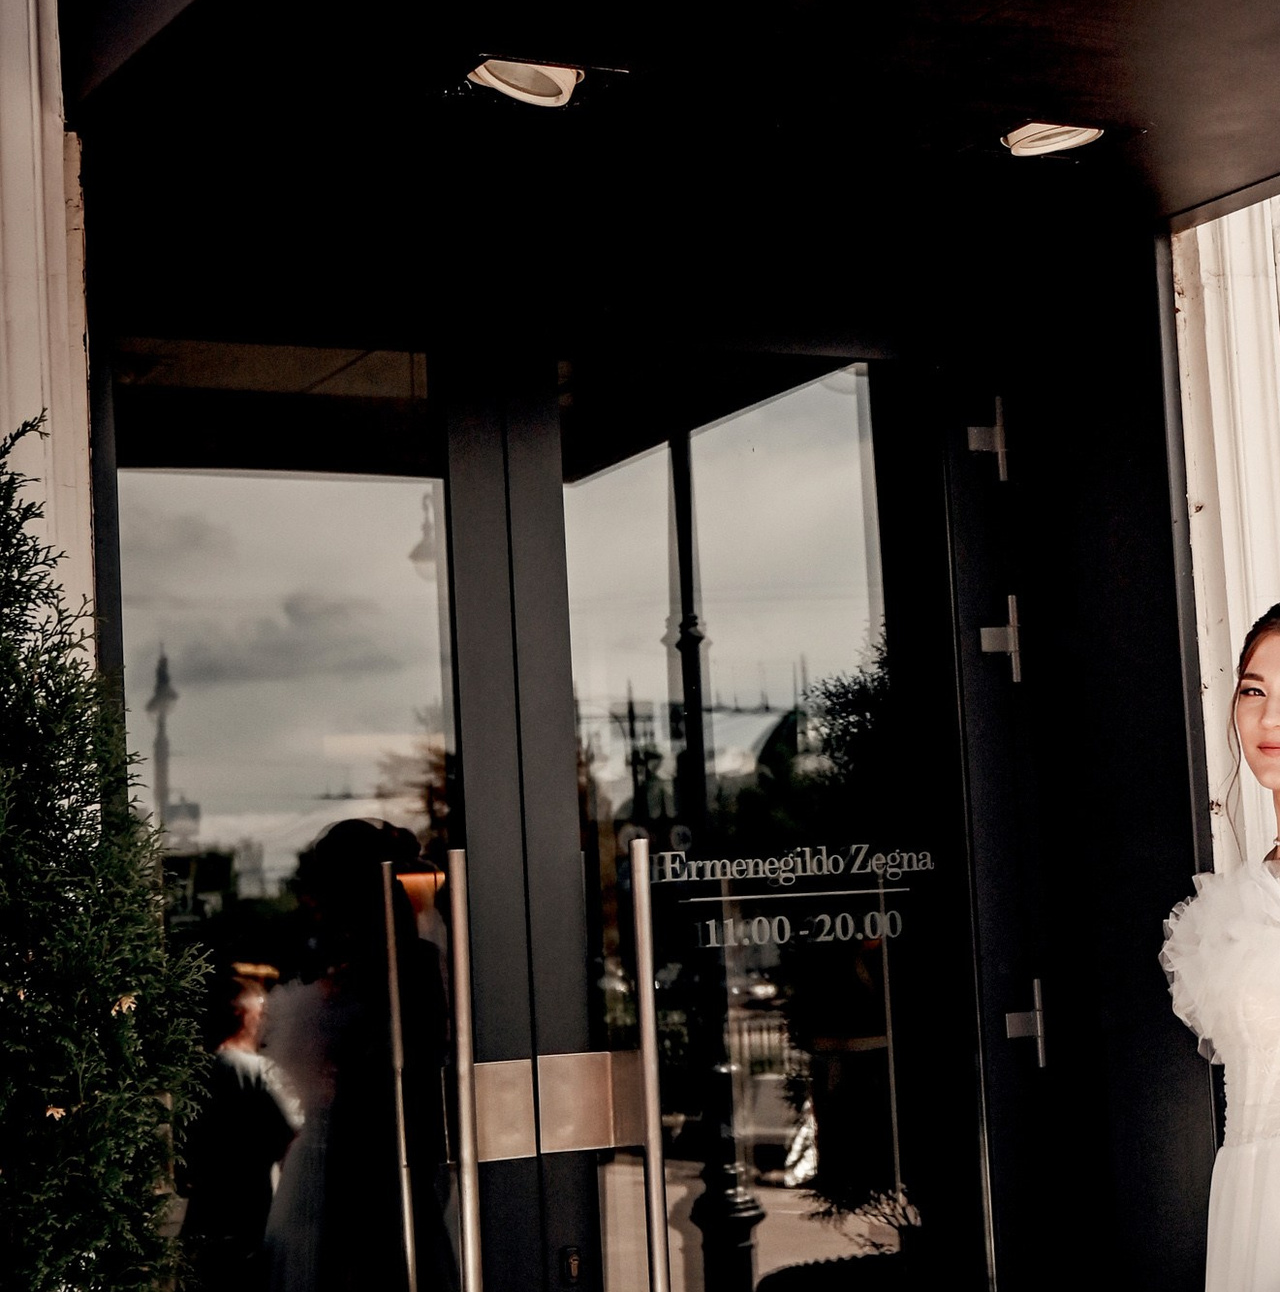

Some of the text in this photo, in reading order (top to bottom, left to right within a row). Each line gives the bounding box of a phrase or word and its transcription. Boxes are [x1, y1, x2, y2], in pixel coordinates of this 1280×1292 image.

[659, 844, 935, 886] Ermenegildo Zegna
[815, 910, 902, 943] 20.00
